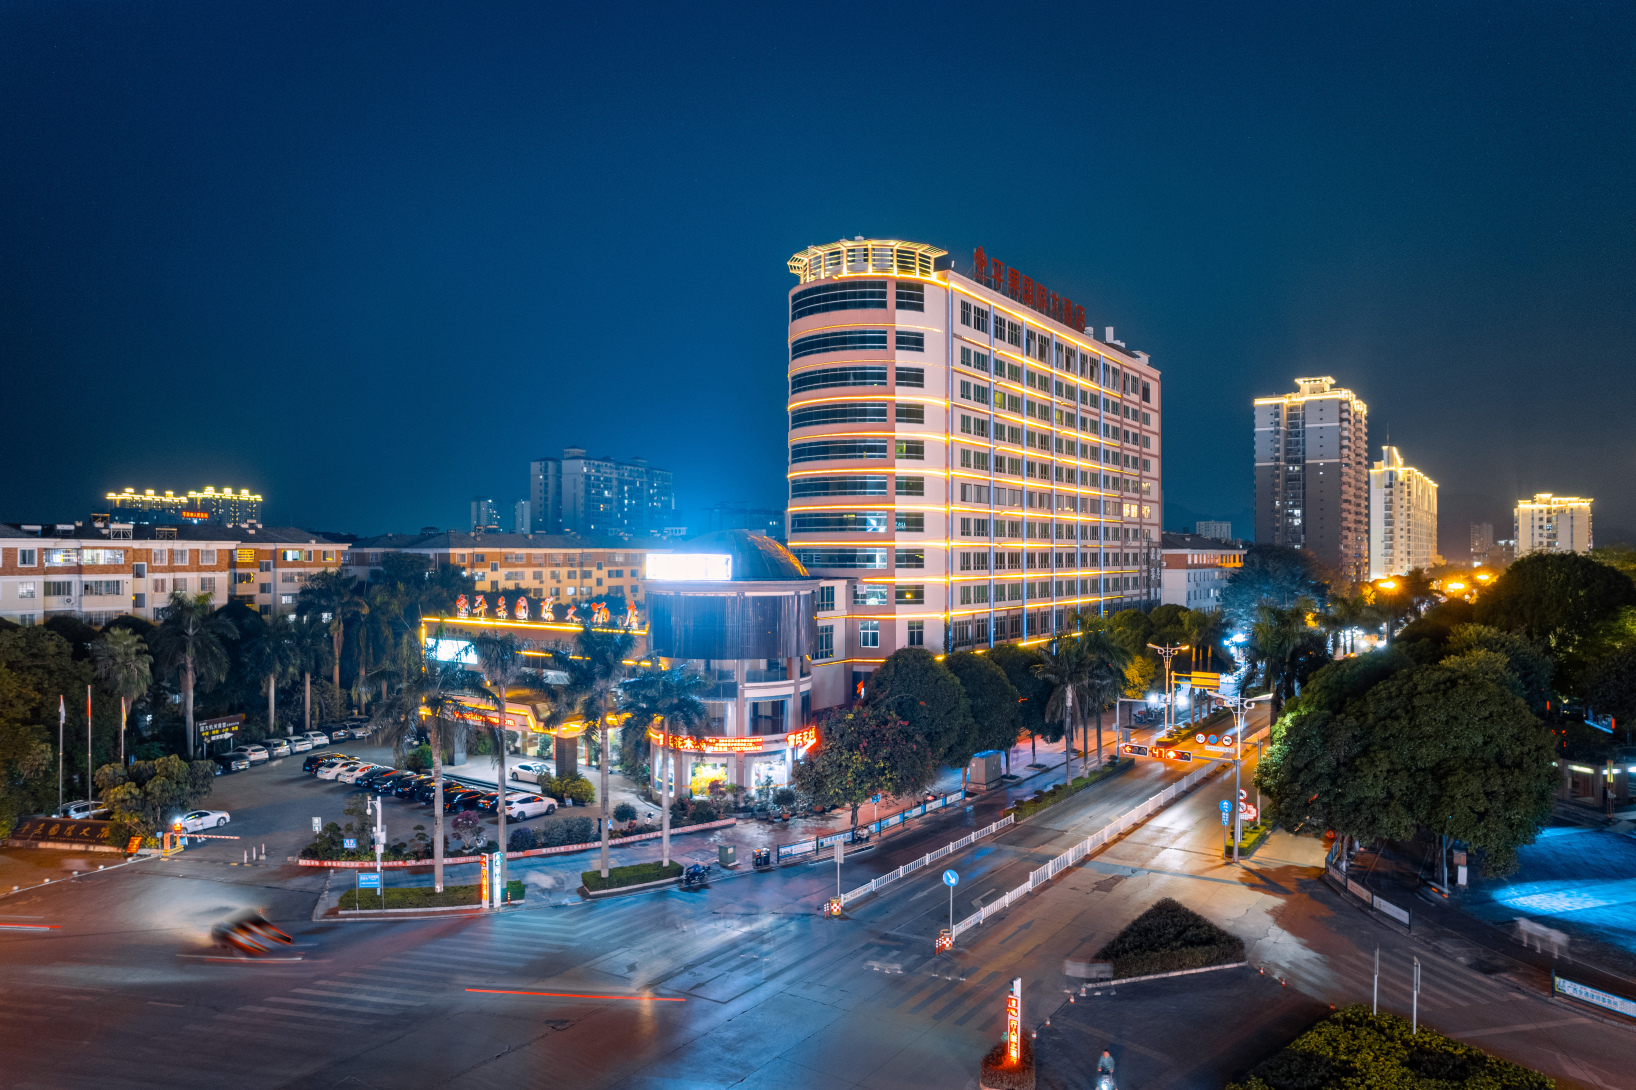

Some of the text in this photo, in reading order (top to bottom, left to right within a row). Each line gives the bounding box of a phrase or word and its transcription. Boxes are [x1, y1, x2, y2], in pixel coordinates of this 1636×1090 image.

[991, 257, 1085, 333] 平果国际大酒店
[1152, 748, 1165, 759] 47
